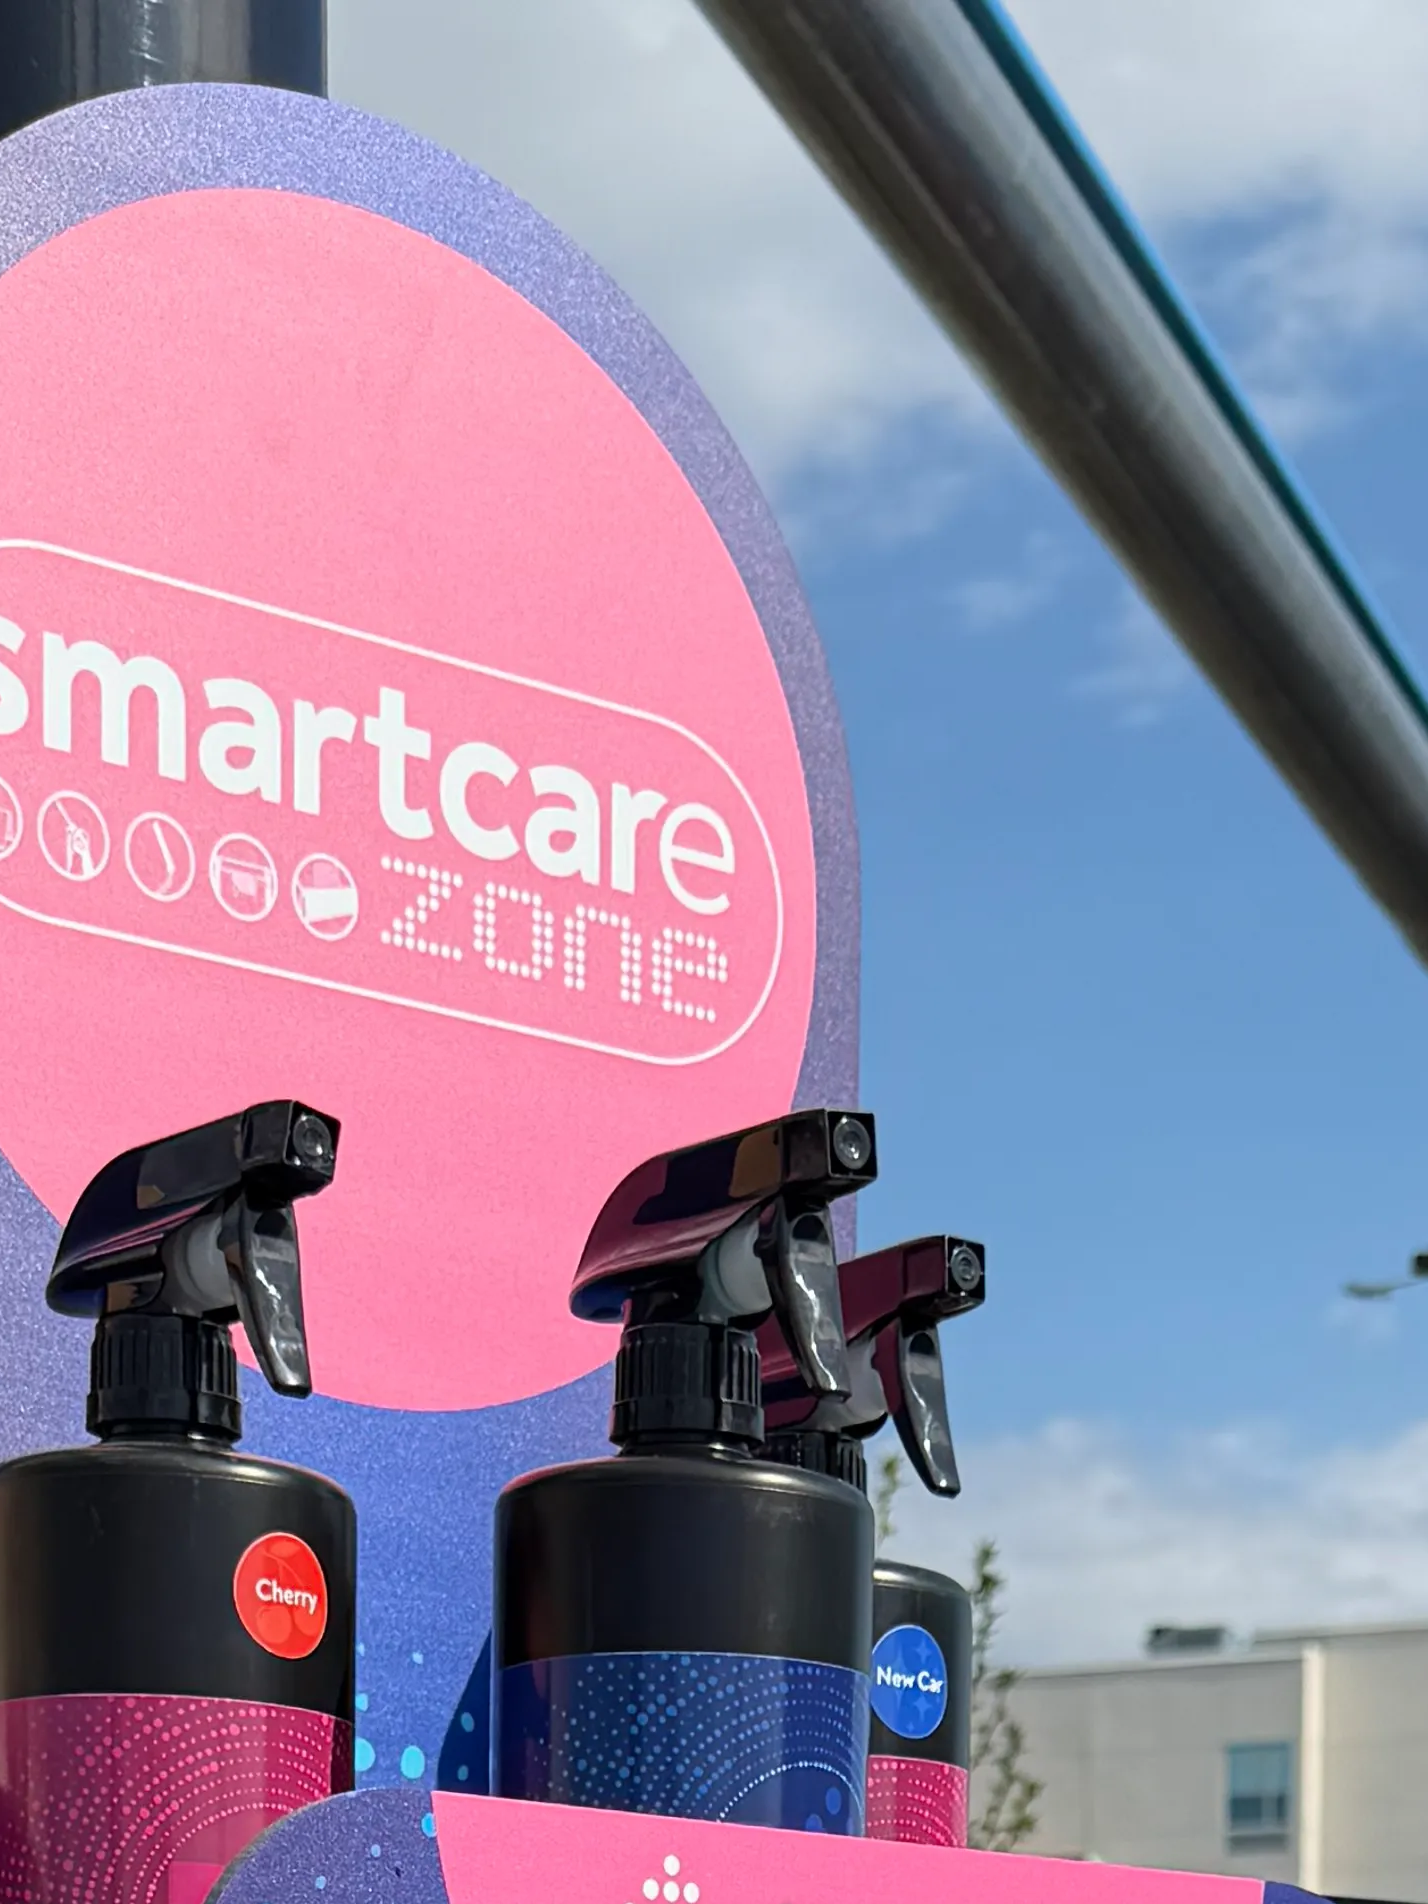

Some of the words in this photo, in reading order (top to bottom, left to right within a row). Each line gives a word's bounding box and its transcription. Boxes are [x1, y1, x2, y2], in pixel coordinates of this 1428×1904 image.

[380, 854, 729, 1022] zone
[255, 1578, 318, 1615] Cherry
[876, 1666, 914, 1688] New
[917, 1669, 944, 1694] Car
